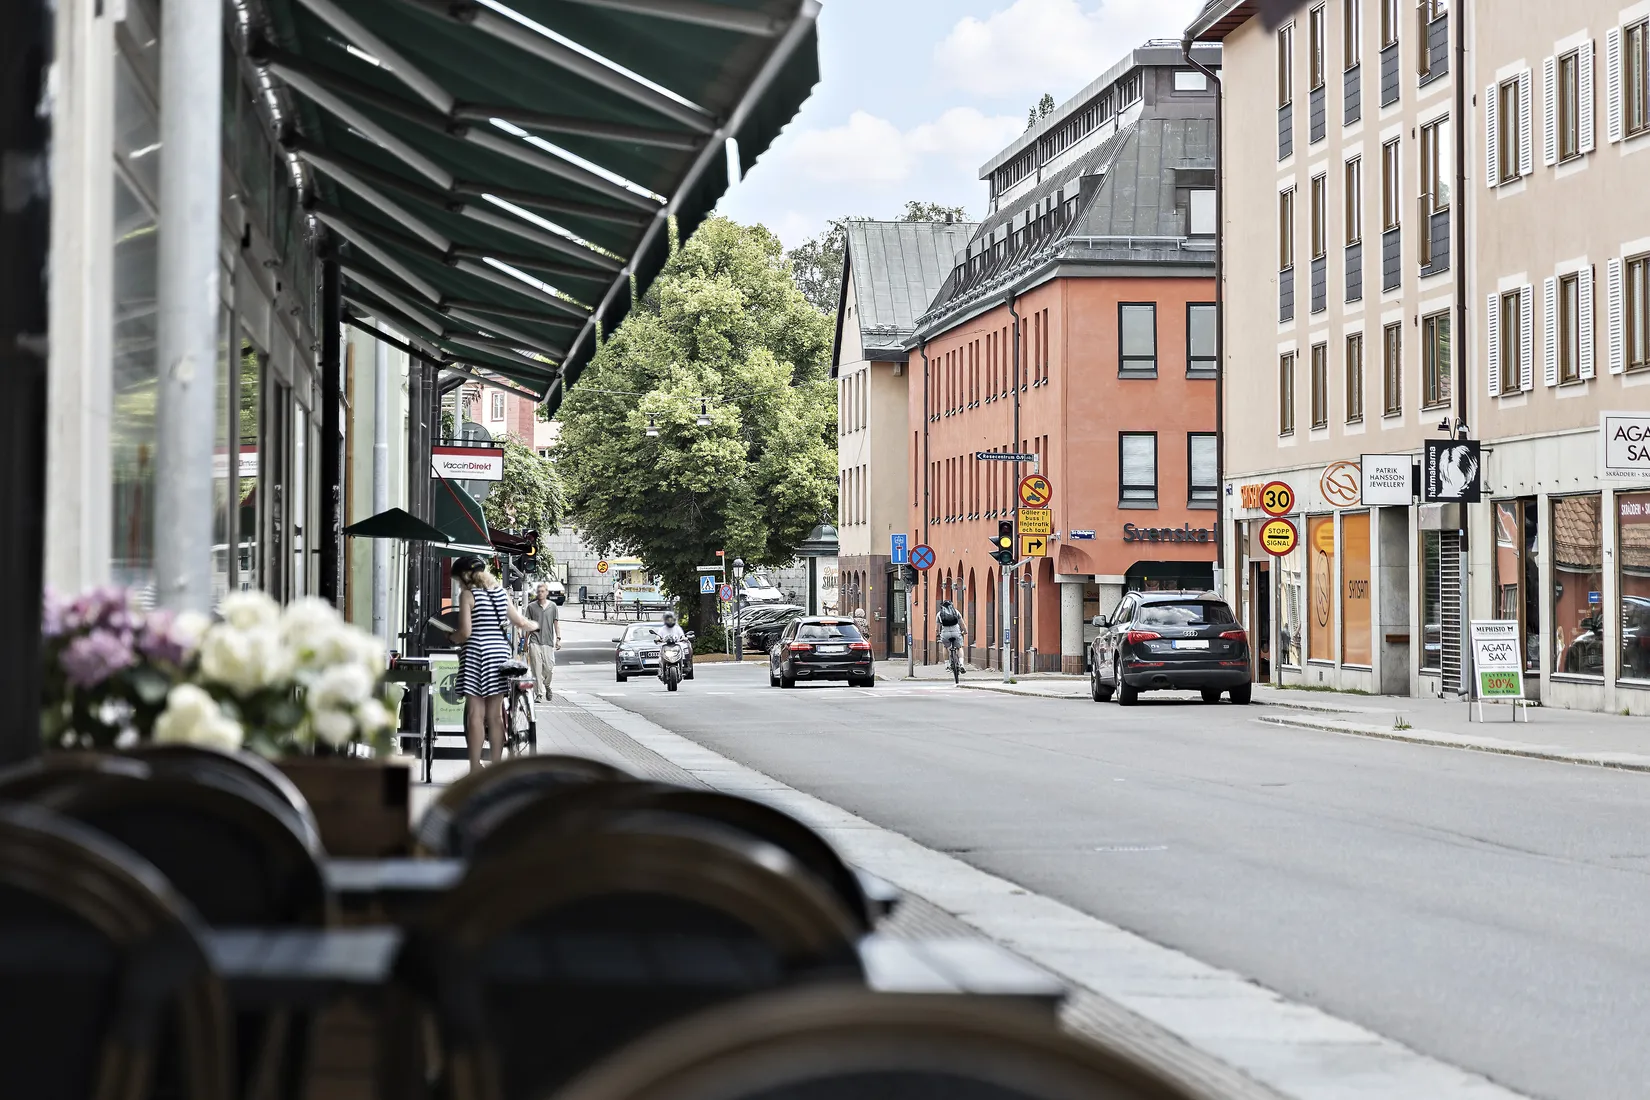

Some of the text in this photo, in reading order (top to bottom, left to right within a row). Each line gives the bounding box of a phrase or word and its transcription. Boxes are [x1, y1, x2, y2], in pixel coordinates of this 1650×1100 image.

[443, 461, 492, 470] VaccinDirekt
[1265, 490, 1290, 508] 30
[1123, 522, 1208, 543] Svenska
[1481, 643, 1513, 652] AGATA
[1488, 652, 1507, 661] SAX
[1488, 678, 1514, 689] 30%
